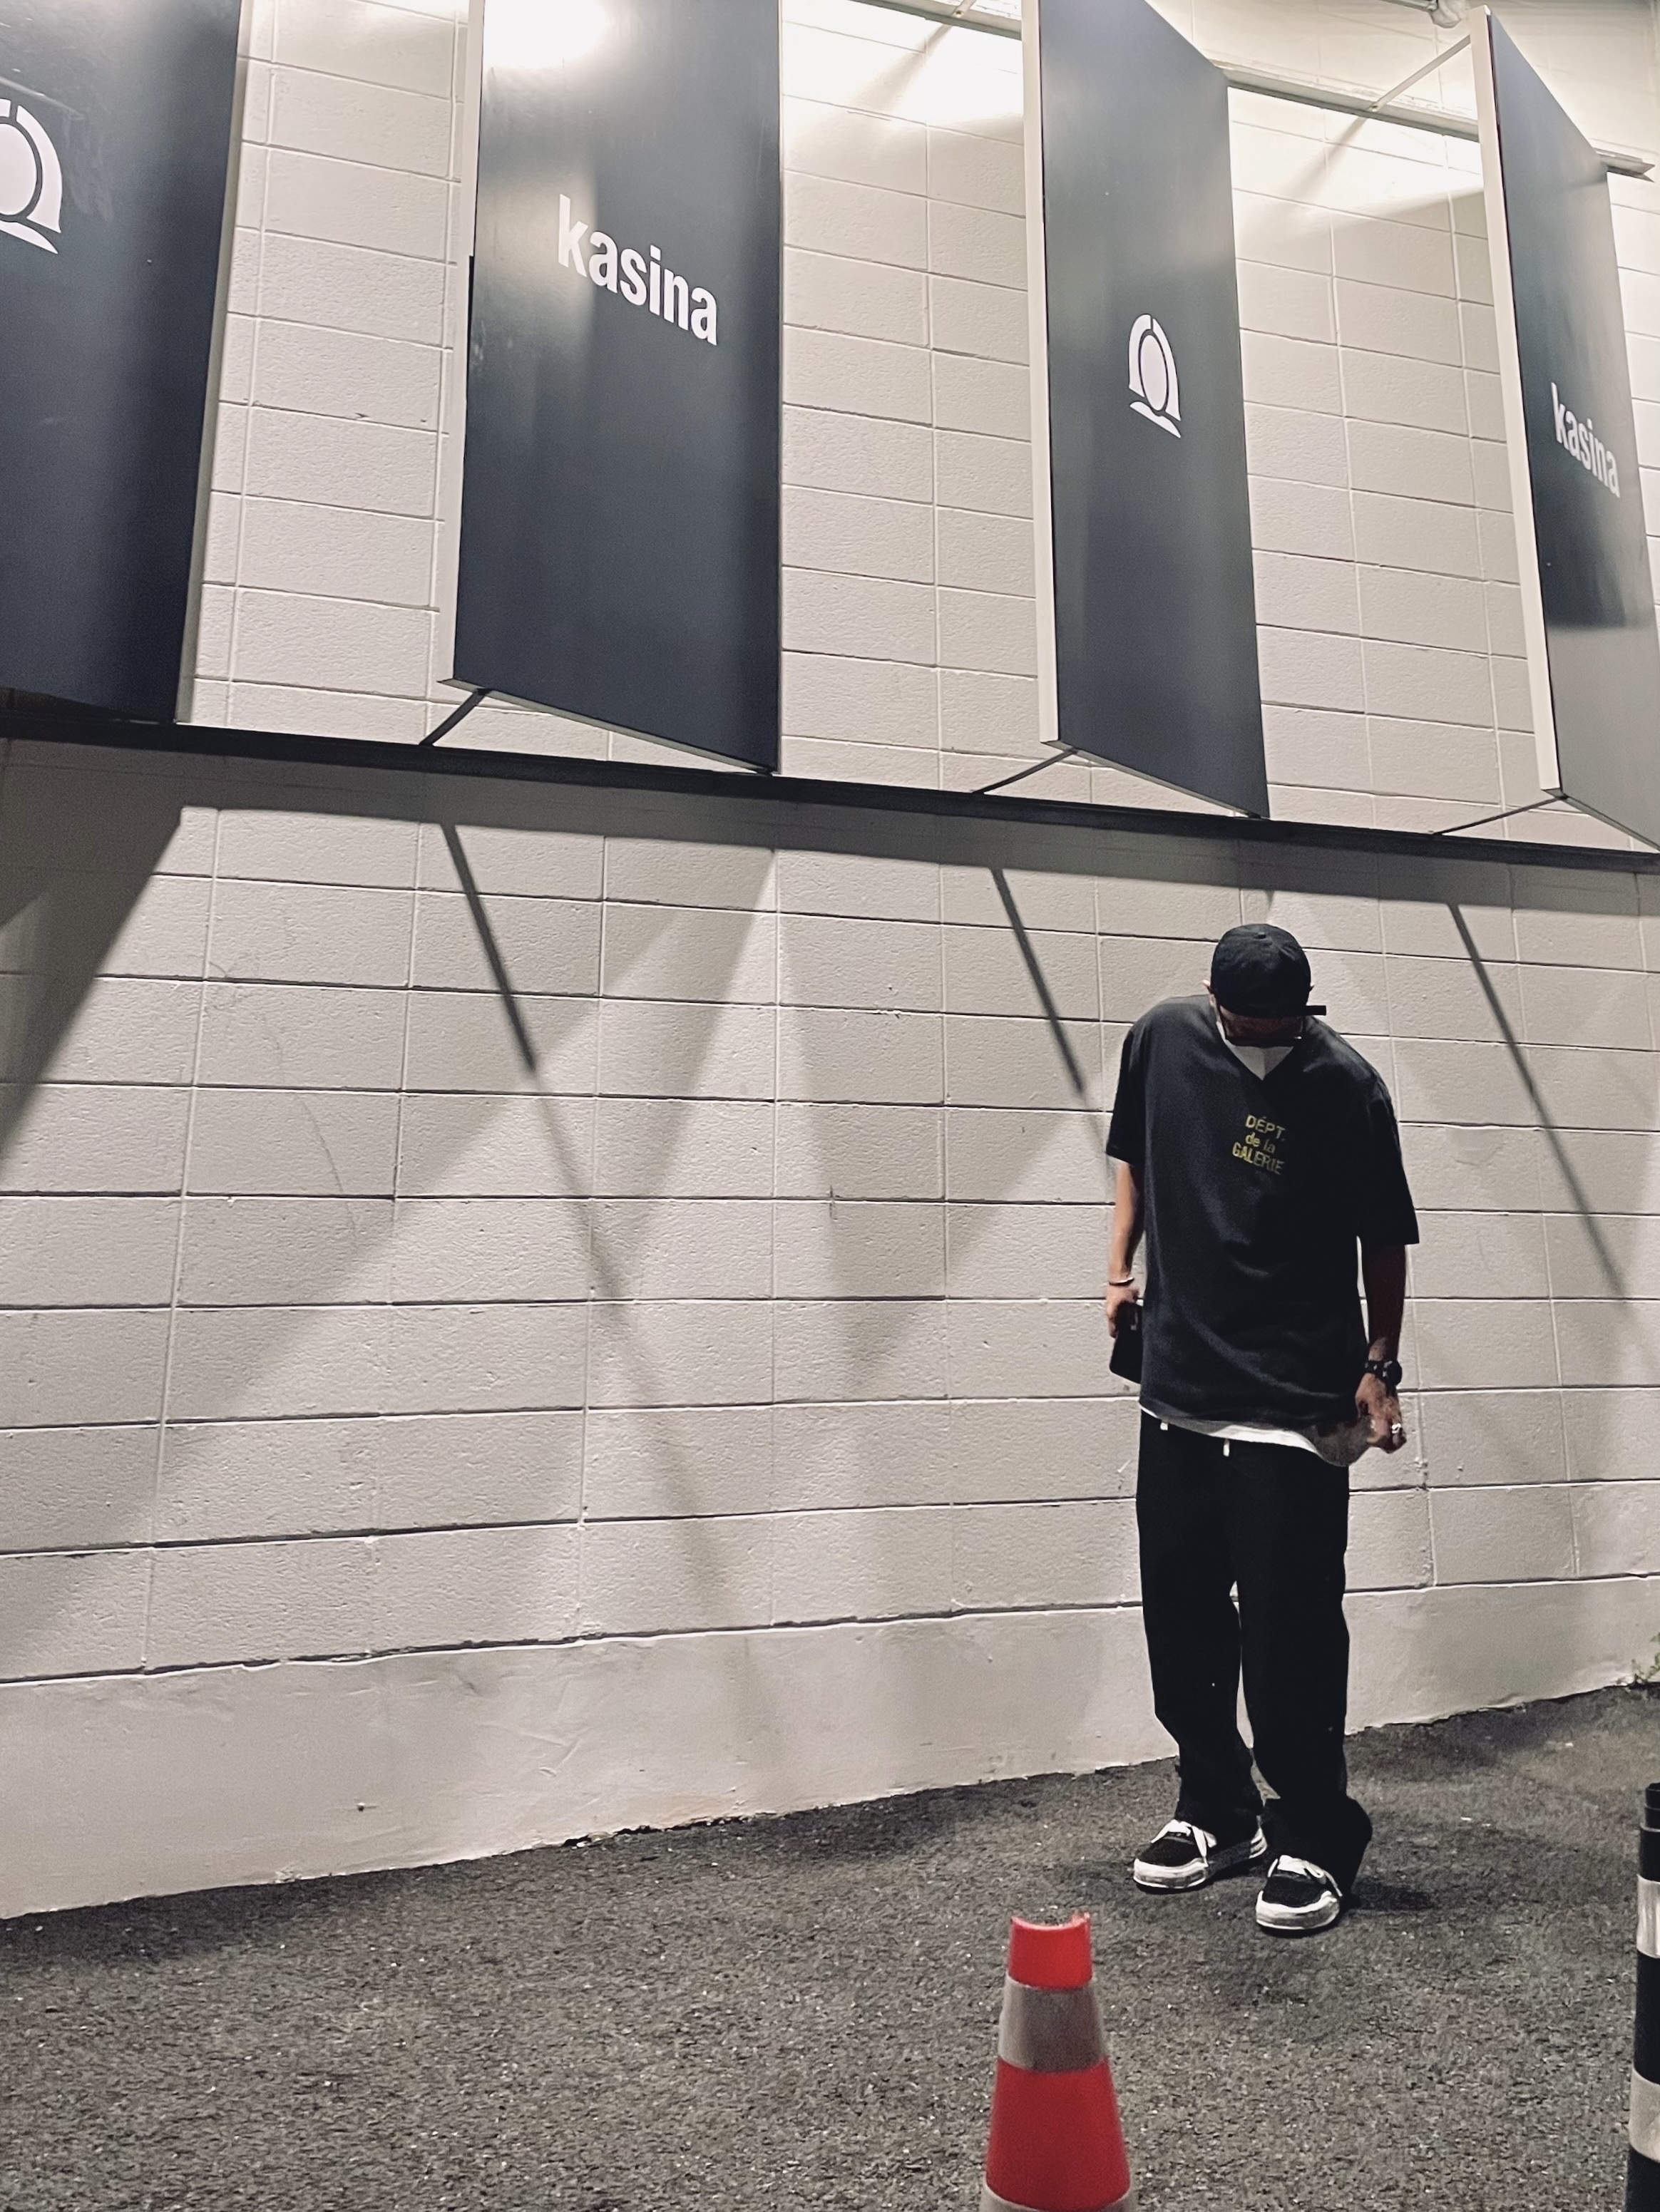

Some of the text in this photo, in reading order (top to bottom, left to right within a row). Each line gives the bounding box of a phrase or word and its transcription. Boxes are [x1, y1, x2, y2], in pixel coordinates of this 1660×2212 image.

[558, 193, 717, 346] kasina
[1551, 382, 1621, 498] kasina
[1232, 1141, 1284, 1175] GALERIE
[1245, 1131, 1276, 1153] de la
